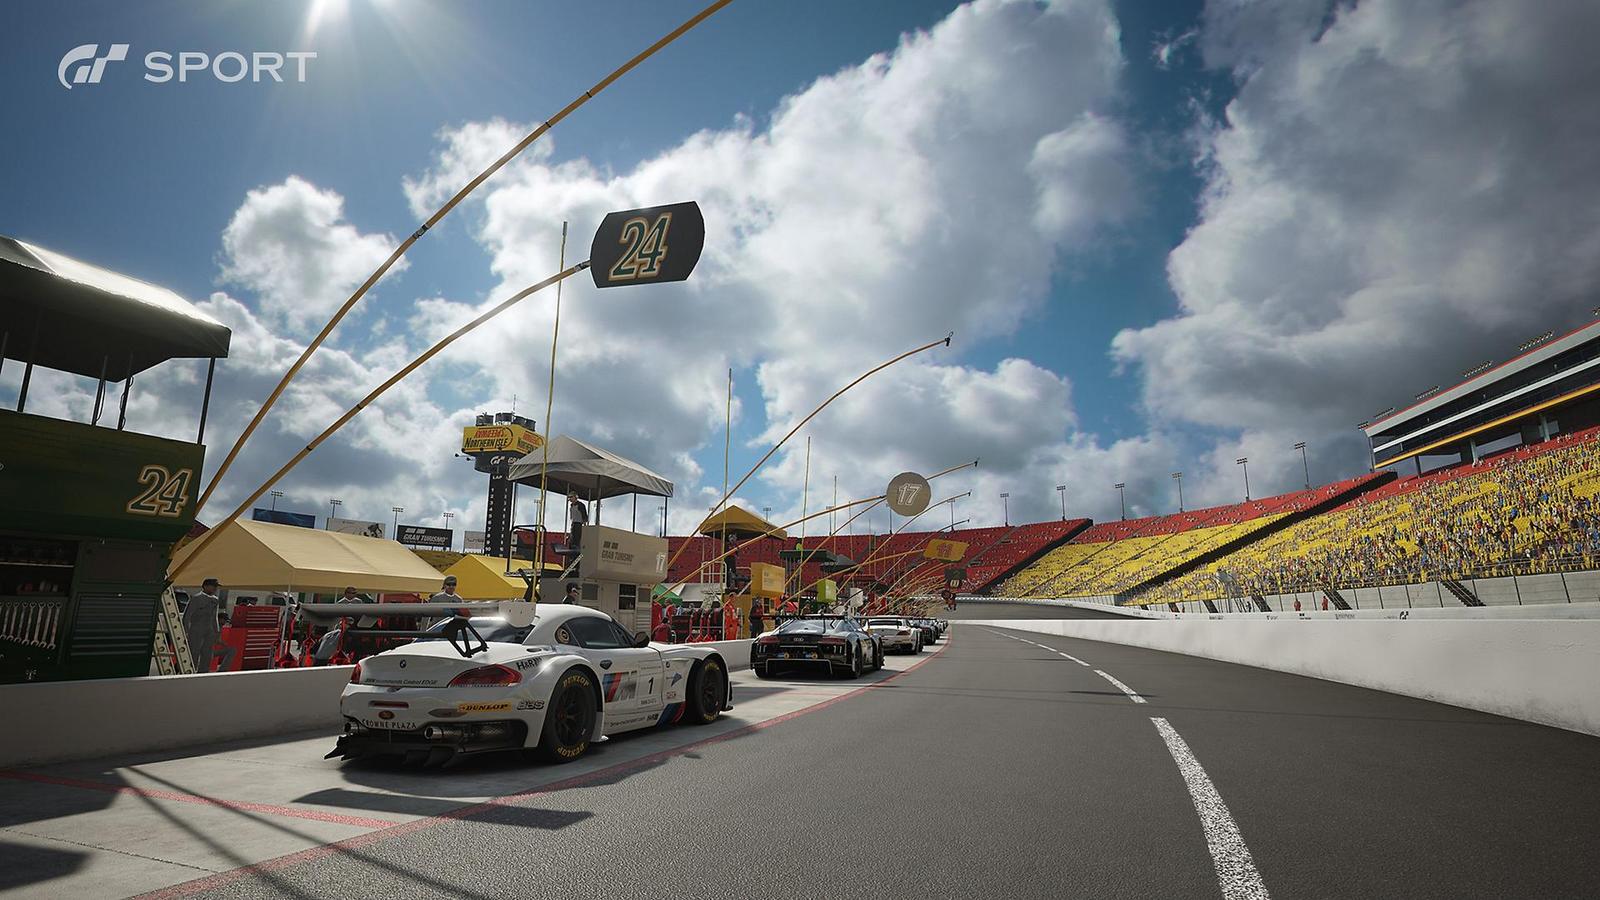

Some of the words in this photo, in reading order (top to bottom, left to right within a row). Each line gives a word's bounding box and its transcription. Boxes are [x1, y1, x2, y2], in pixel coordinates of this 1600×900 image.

[608, 211, 672, 281] 24
[464, 437, 495, 448] NORTHERN
[495, 437, 508, 448] ISLE
[126, 464, 193, 518] 24
[897, 482, 922, 506] 17
[403, 533, 420, 542] GRAN
[562, 674, 590, 689] DUNLOP
[648, 676, 654, 695] 1
[463, 703, 510, 711] DUNLOP
[516, 700, 545, 711] BBS
[391, 721, 417, 729] PLAZA
[556, 743, 586, 758] DUNLOP
